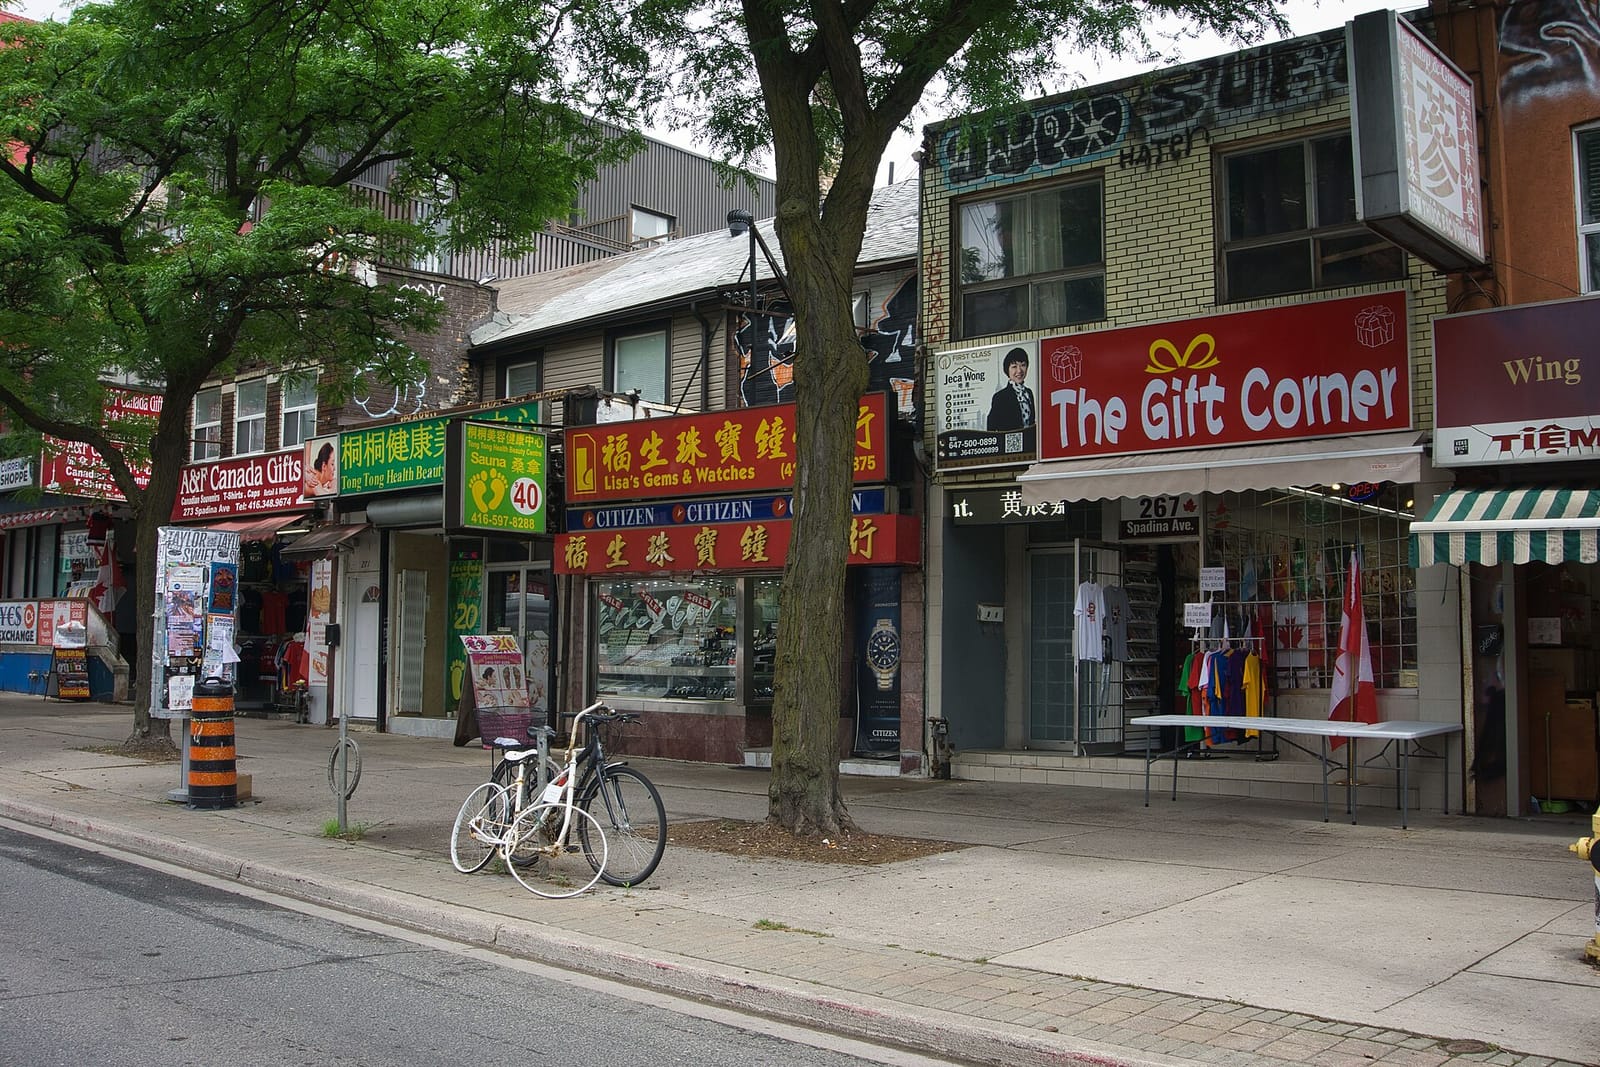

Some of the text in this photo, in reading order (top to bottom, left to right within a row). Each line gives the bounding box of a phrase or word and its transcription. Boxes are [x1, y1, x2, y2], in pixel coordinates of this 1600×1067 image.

[1410, 36, 1431, 74] Shop
[943, 373, 962, 385] Jeca
[963, 371, 985, 382] Wong
[1503, 356, 1582, 385] Wing
[1051, 386, 1128, 449] The
[1141, 372, 1226, 442] Gift
[1240, 366, 1397, 432] Corner
[602, 405, 875, 473] 福生珠寶鐘行
[471, 451, 506, 468] Sauna
[180, 455, 301, 494] A&F Canada Gifts
[341, 475, 362, 491] Tong
[363, 472, 385, 488] Tong
[386, 466, 414, 484] Health
[643, 468, 679, 487] Gems
[682, 468, 692, 484] &
[695, 464, 756, 483] Watches
[247, 487, 260, 498] Caps
[183, 496, 292, 516] 273 Spadina Ave Tel: 416.348.9674
[686, 501, 753, 522] CITIZEN
[1140, 496, 1180, 519] 267
[471, 512, 535, 530] 416-597-8288
[596, 507, 655, 528] CITIZEN
[1127, 518, 1194, 536] Spadina Ave.
[168, 531, 207, 549] TAYLOR
[564, 517, 878, 570] 福生珠寶鐘行
[182, 548, 217, 562] SWIFT
[686, 592, 710, 608] SALE
[453, 602, 479, 631] 20
[497, 636, 516, 651] 20
[872, 729, 898, 737] CITIZEN
